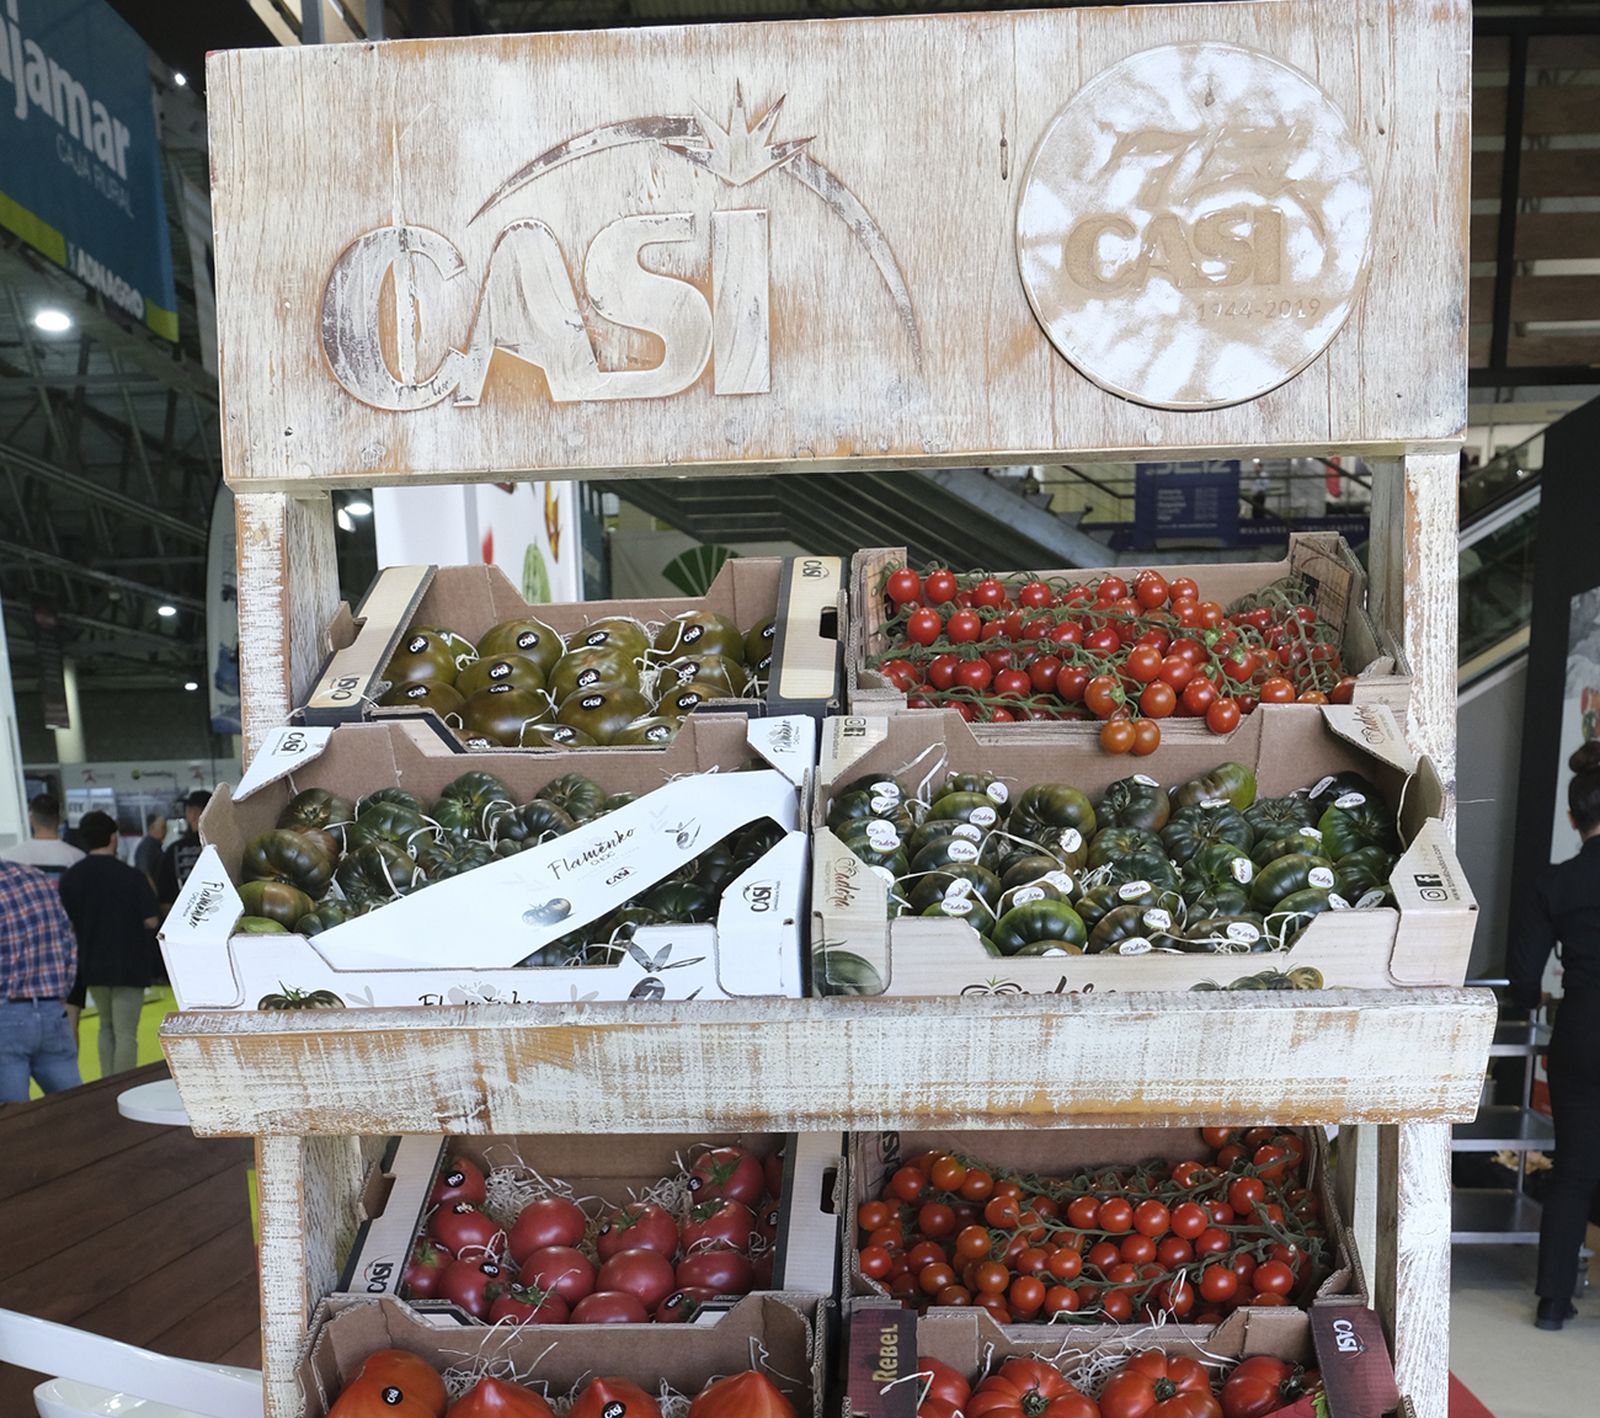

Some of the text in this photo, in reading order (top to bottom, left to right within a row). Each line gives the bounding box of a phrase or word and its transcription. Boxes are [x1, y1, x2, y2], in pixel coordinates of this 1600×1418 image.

[1064, 205, 1282, 293] CASI
[321, 208, 771, 412] CASI
[1199, 298, 1320, 321] 1944-2019
[803, 560, 822, 578] CASI
[519, 635, 536, 648] CASI
[587, 632, 605, 645] CASI
[683, 626, 701, 642] CASI
[409, 637, 428, 653] CASI
[491, 666, 509, 679] CASI
[579, 671, 597, 686] CASI
[582, 697, 602, 708] CASI
[679, 695, 698, 707] CASI
[605, 869, 631, 886] CASI
[750, 886, 772, 913] CASI
[366, 1262, 394, 1294] CASI
[1332, 1319, 1358, 1354] CASI
[604, 1405, 621, 1418] CASI
